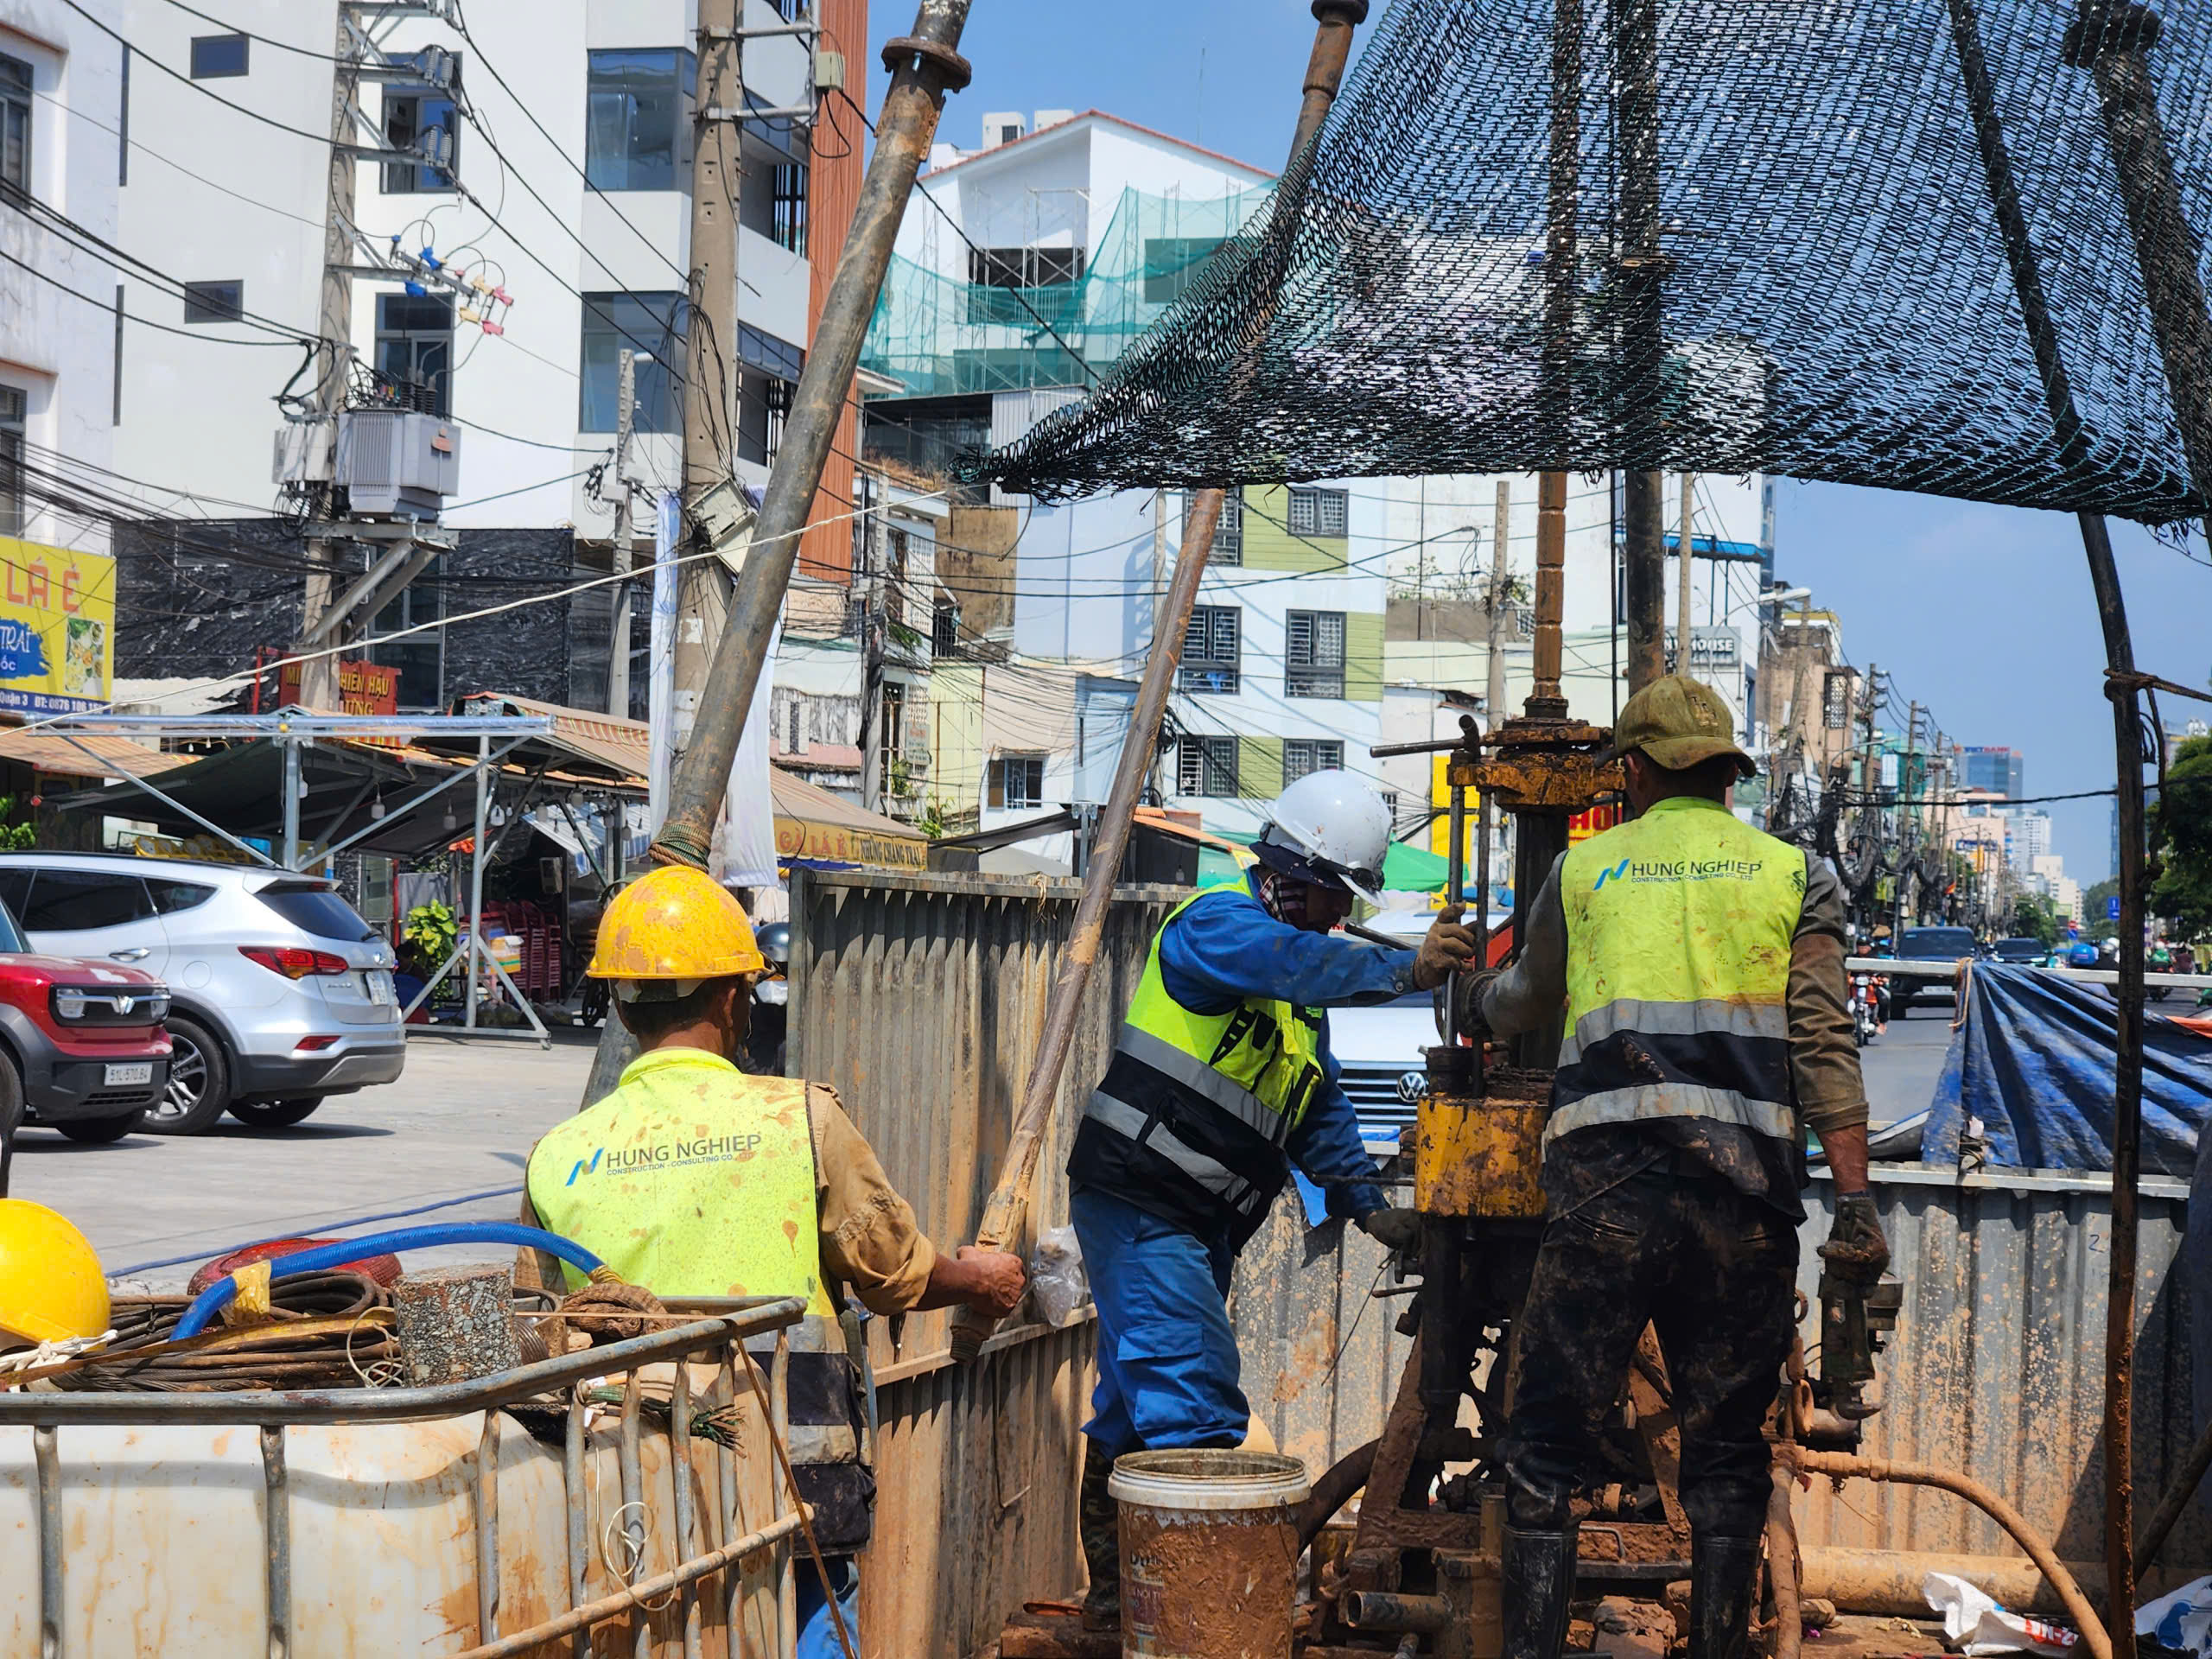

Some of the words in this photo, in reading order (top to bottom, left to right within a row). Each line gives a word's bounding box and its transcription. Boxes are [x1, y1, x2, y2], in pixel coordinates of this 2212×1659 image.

[7, 556, 49, 609] LÁ
[62, 563, 80, 613] É
[0, 654, 16, 671] ốc
[340, 669, 365, 695] HIÊN
[22, 694, 29, 706] 3
[1632, 861, 1684, 876] HUNG
[1690, 859, 1761, 874] NGHIEP
[607, 1145, 669, 1168] HUNG
[677, 1135, 761, 1159] NGHIEP
[607, 1163, 664, 1175] CONSTRUCTION
[671, 1155, 719, 1167] CONSULTING
